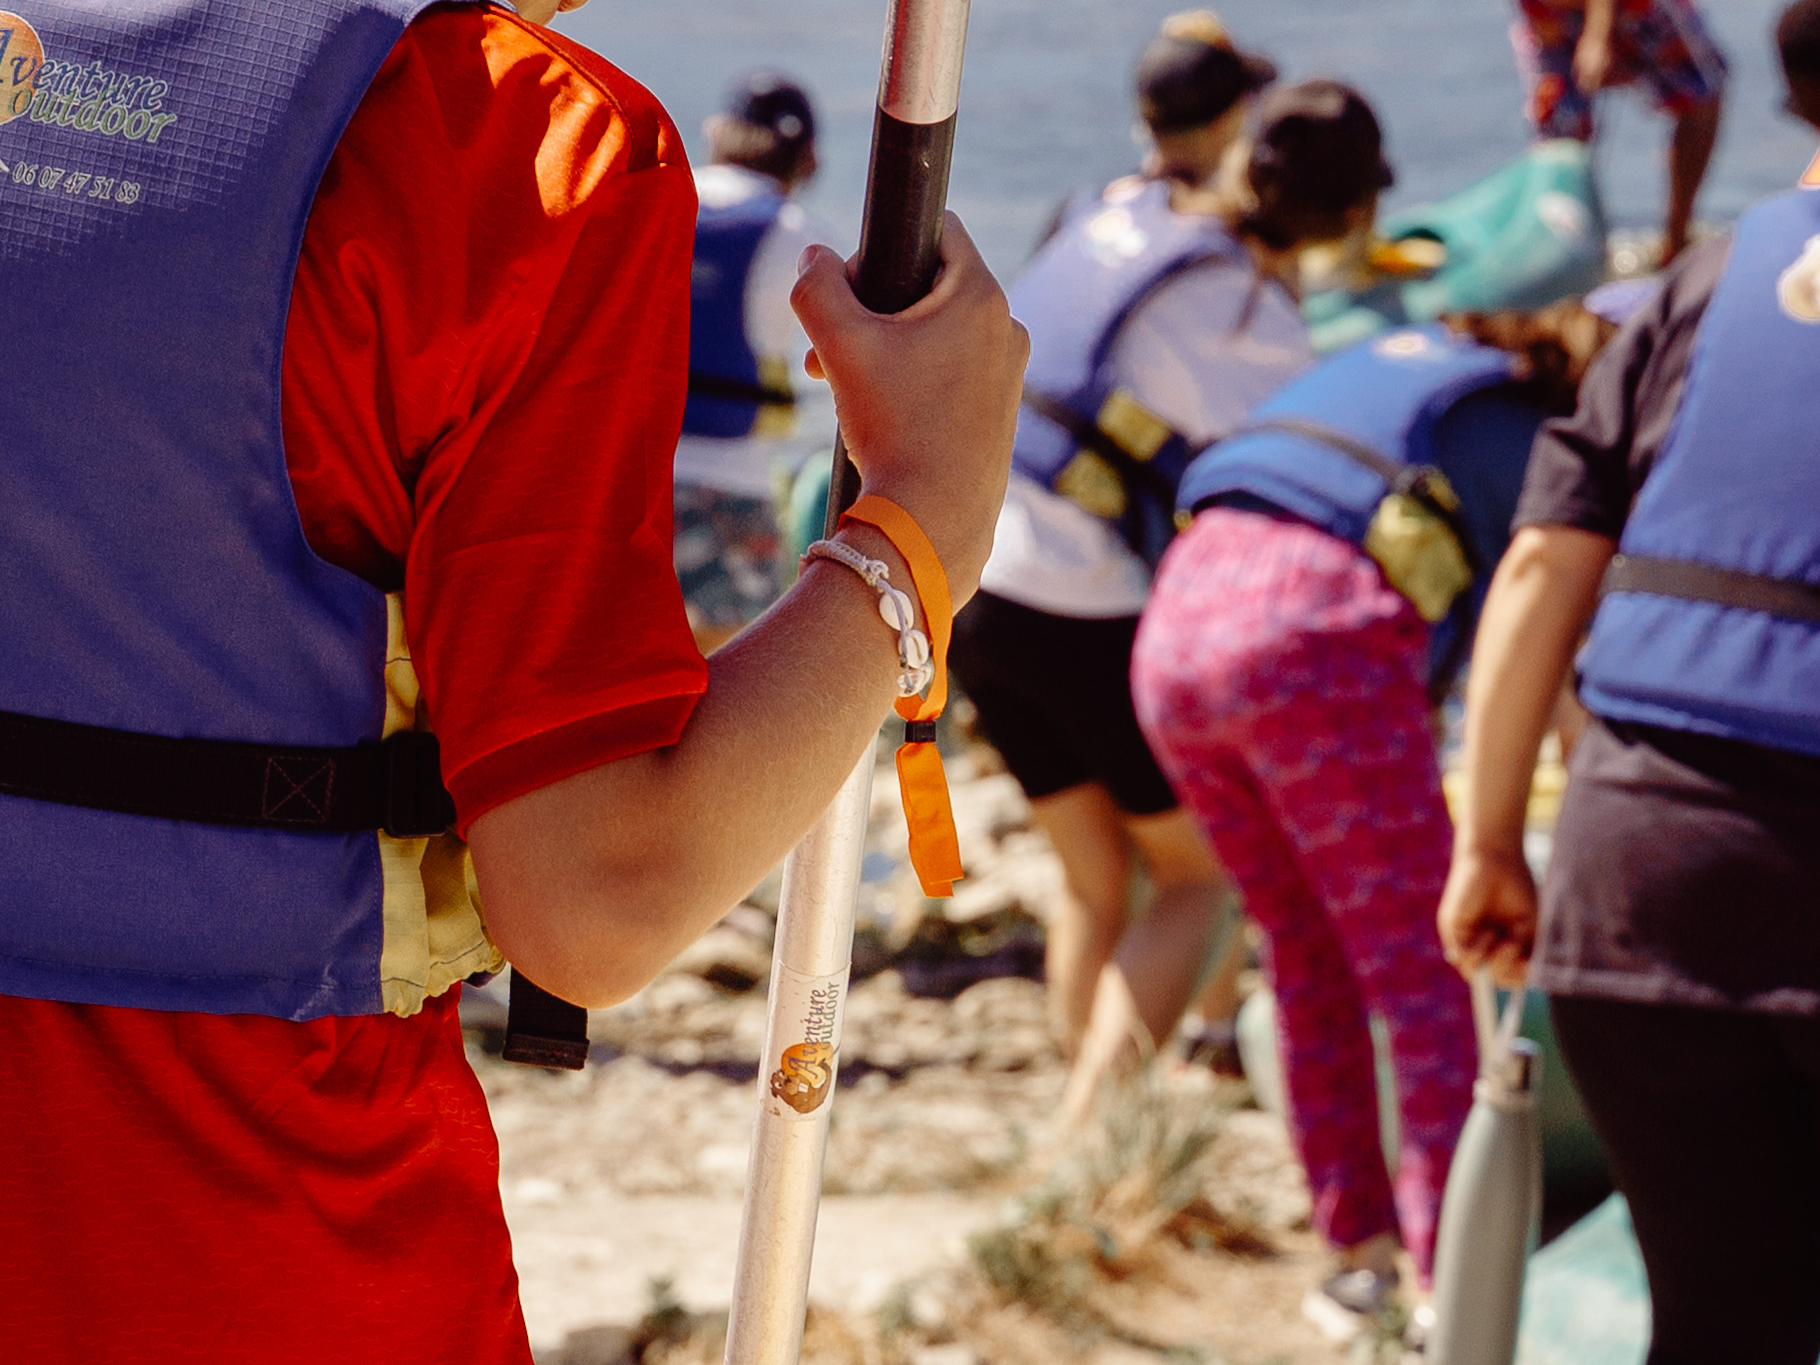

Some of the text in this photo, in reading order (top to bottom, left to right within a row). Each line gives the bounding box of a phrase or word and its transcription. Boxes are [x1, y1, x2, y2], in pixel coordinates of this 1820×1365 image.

[8, 87, 177, 143] outdoor
[13, 161, 140, 204] 06 07 47 51 83
[789, 989, 826, 1079] Aventure
